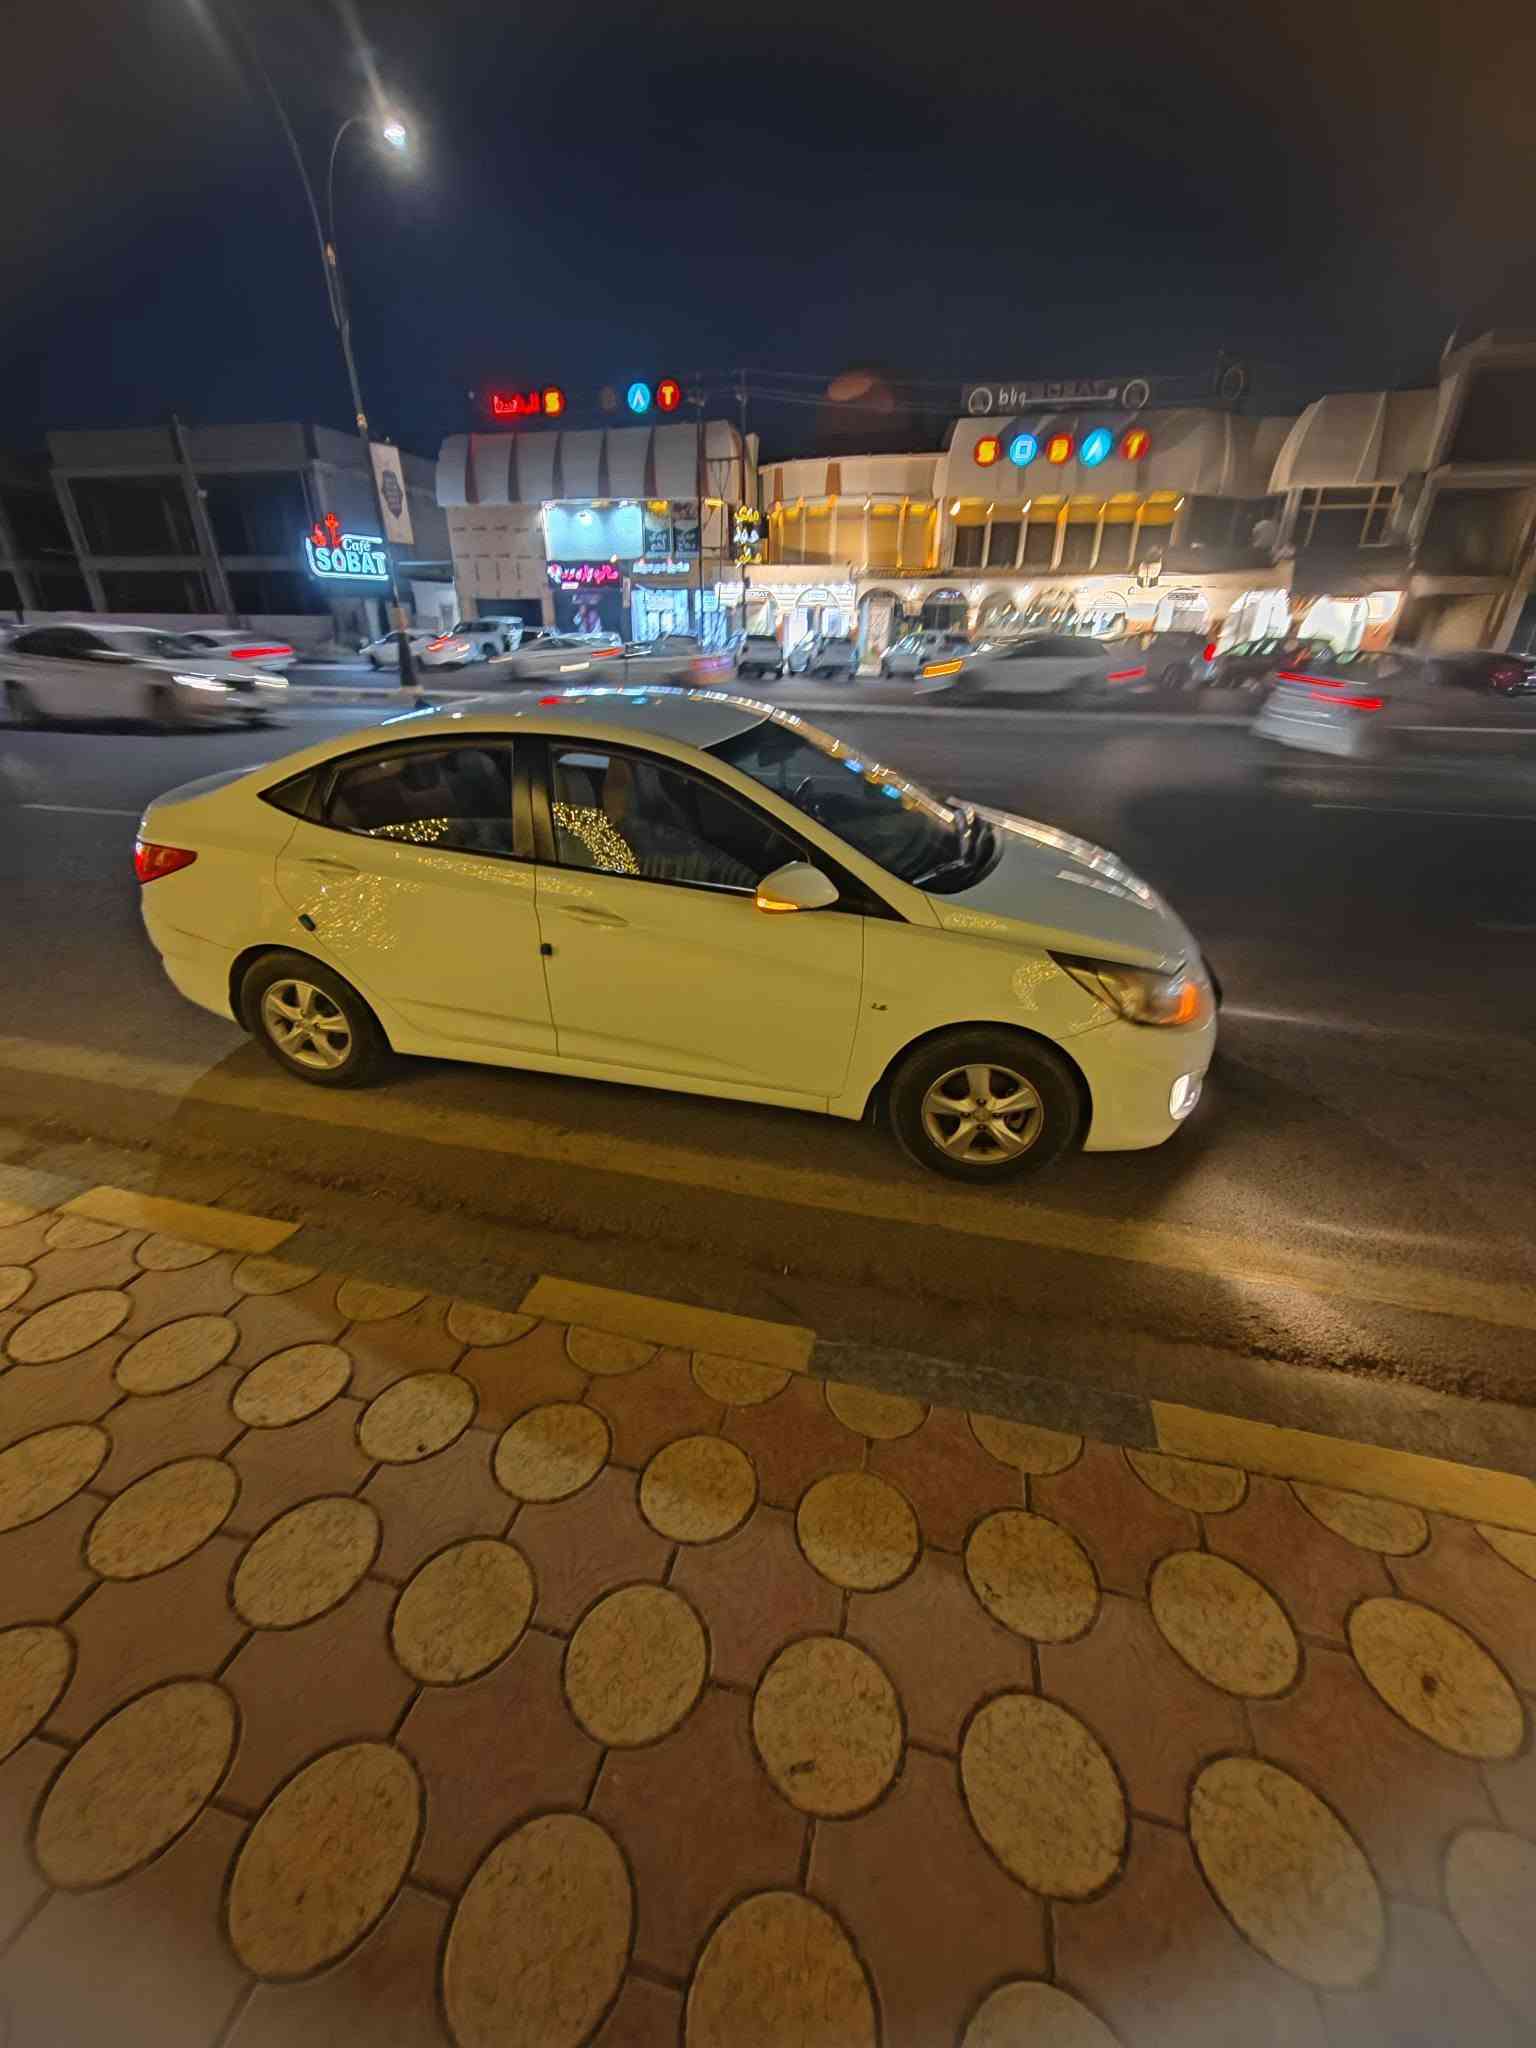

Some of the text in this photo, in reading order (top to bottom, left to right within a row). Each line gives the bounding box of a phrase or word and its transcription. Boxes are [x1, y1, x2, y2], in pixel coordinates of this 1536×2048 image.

[976, 429, 1148, 466] SOBAT
[343, 539, 371, 553] Café
[315, 547, 386, 575] SOBAT
